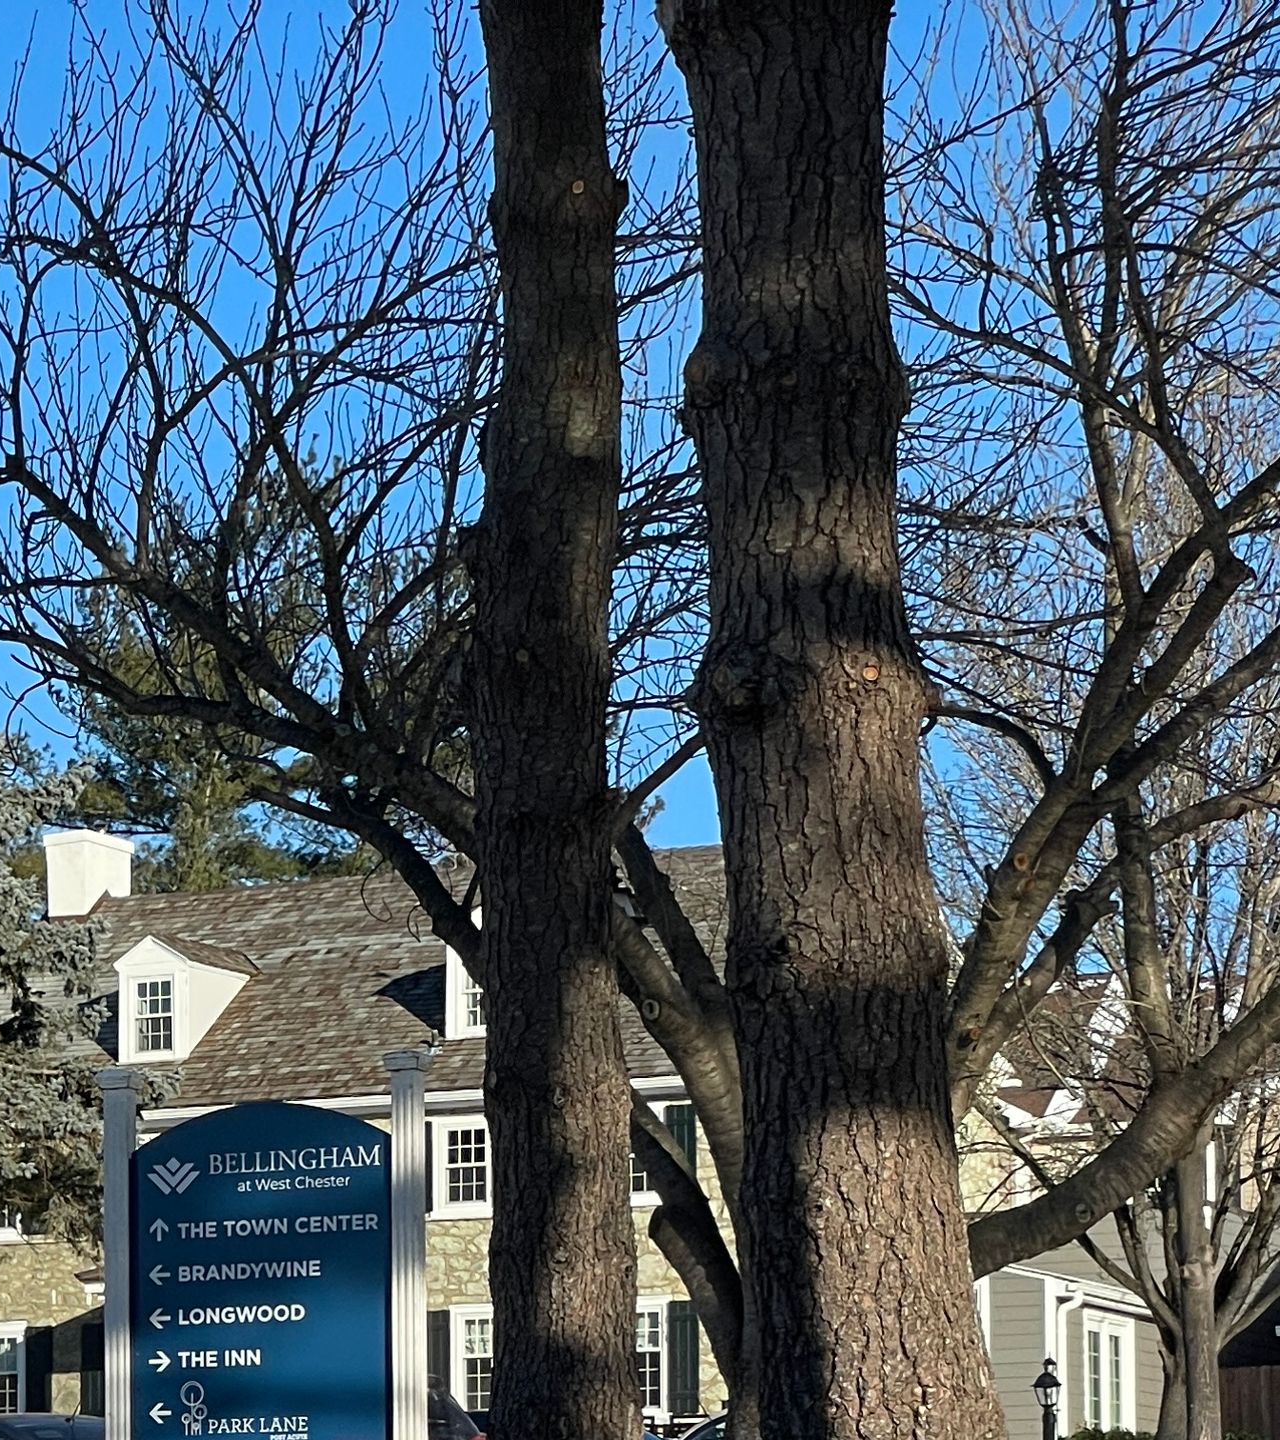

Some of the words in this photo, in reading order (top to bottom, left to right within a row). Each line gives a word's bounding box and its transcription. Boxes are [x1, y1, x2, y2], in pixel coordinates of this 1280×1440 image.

[208, 1144, 381, 1175] BELLINGHAM
[237, 1181, 252, 1192] at
[255, 1178, 291, 1191] West
[295, 1175, 351, 1189] Chester
[177, 1221, 217, 1239] THE
[223, 1218, 288, 1237] TOWN
[295, 1213, 378, 1234] CENTER
[178, 1260, 321, 1282] BRANDYWINE
[178, 1304, 306, 1326] LONGWOOD
[178, 1351, 218, 1368] THE
[224, 1349, 261, 1366] INN
[208, 1418, 255, 1434] PARK
[259, 1416, 309, 1433] LANE
